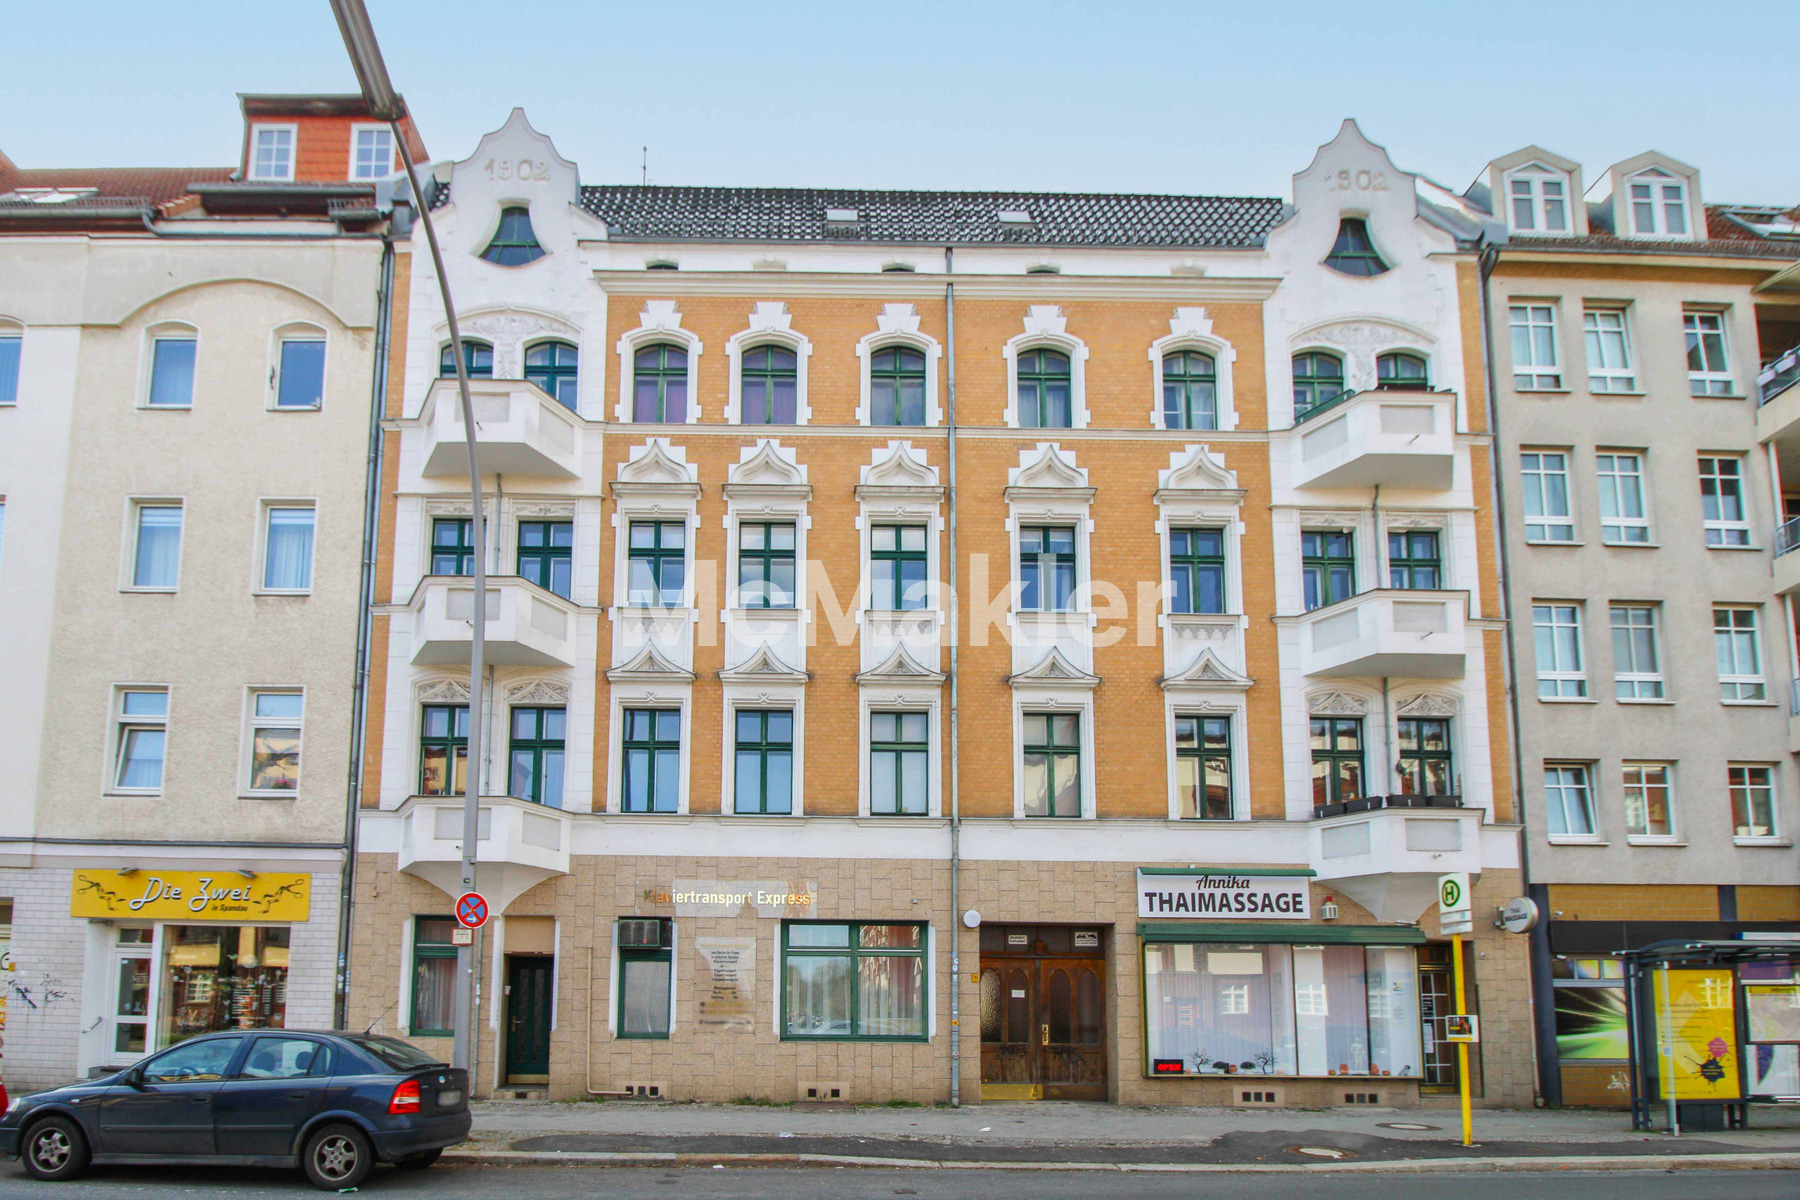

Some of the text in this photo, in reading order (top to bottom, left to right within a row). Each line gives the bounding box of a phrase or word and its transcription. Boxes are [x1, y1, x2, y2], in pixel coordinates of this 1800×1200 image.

[485, 159, 550, 181] 1902
[1324, 169, 1388, 191] 1902
[1196, 874, 1250, 890] Annika
[129, 877, 251, 912] Die Zwei
[643, 889, 811, 907] Klaviertransport Express
[1144, 892, 1304, 913] THAIMASSAGE
[220, 904, 248, 912] Spandau
[1157, 1063, 1182, 1071] OPEN
